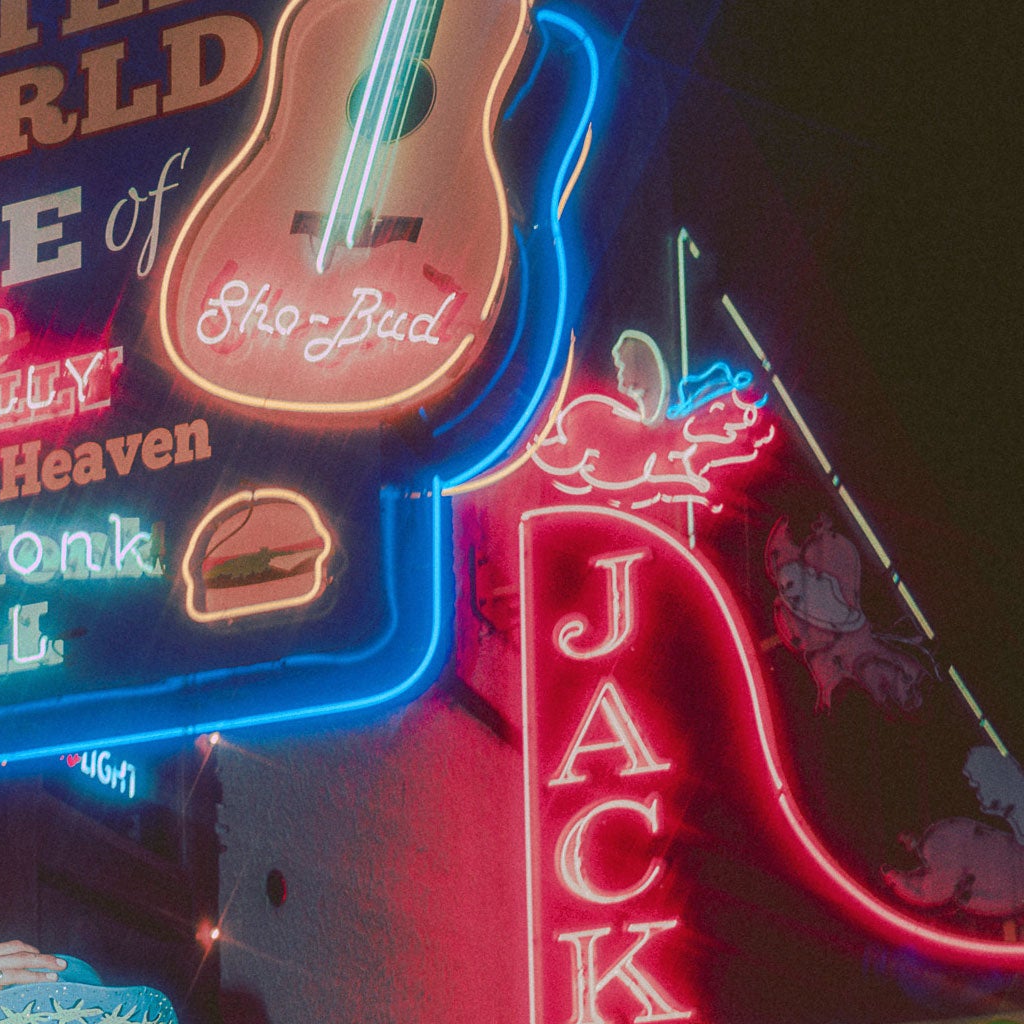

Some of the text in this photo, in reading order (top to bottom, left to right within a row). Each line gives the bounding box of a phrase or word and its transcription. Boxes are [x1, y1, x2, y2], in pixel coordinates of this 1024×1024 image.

[105, 147, 190, 277] of
[197, 279, 456, 362] Sho-Bud
[0, 417, 212, 501] Heaven
